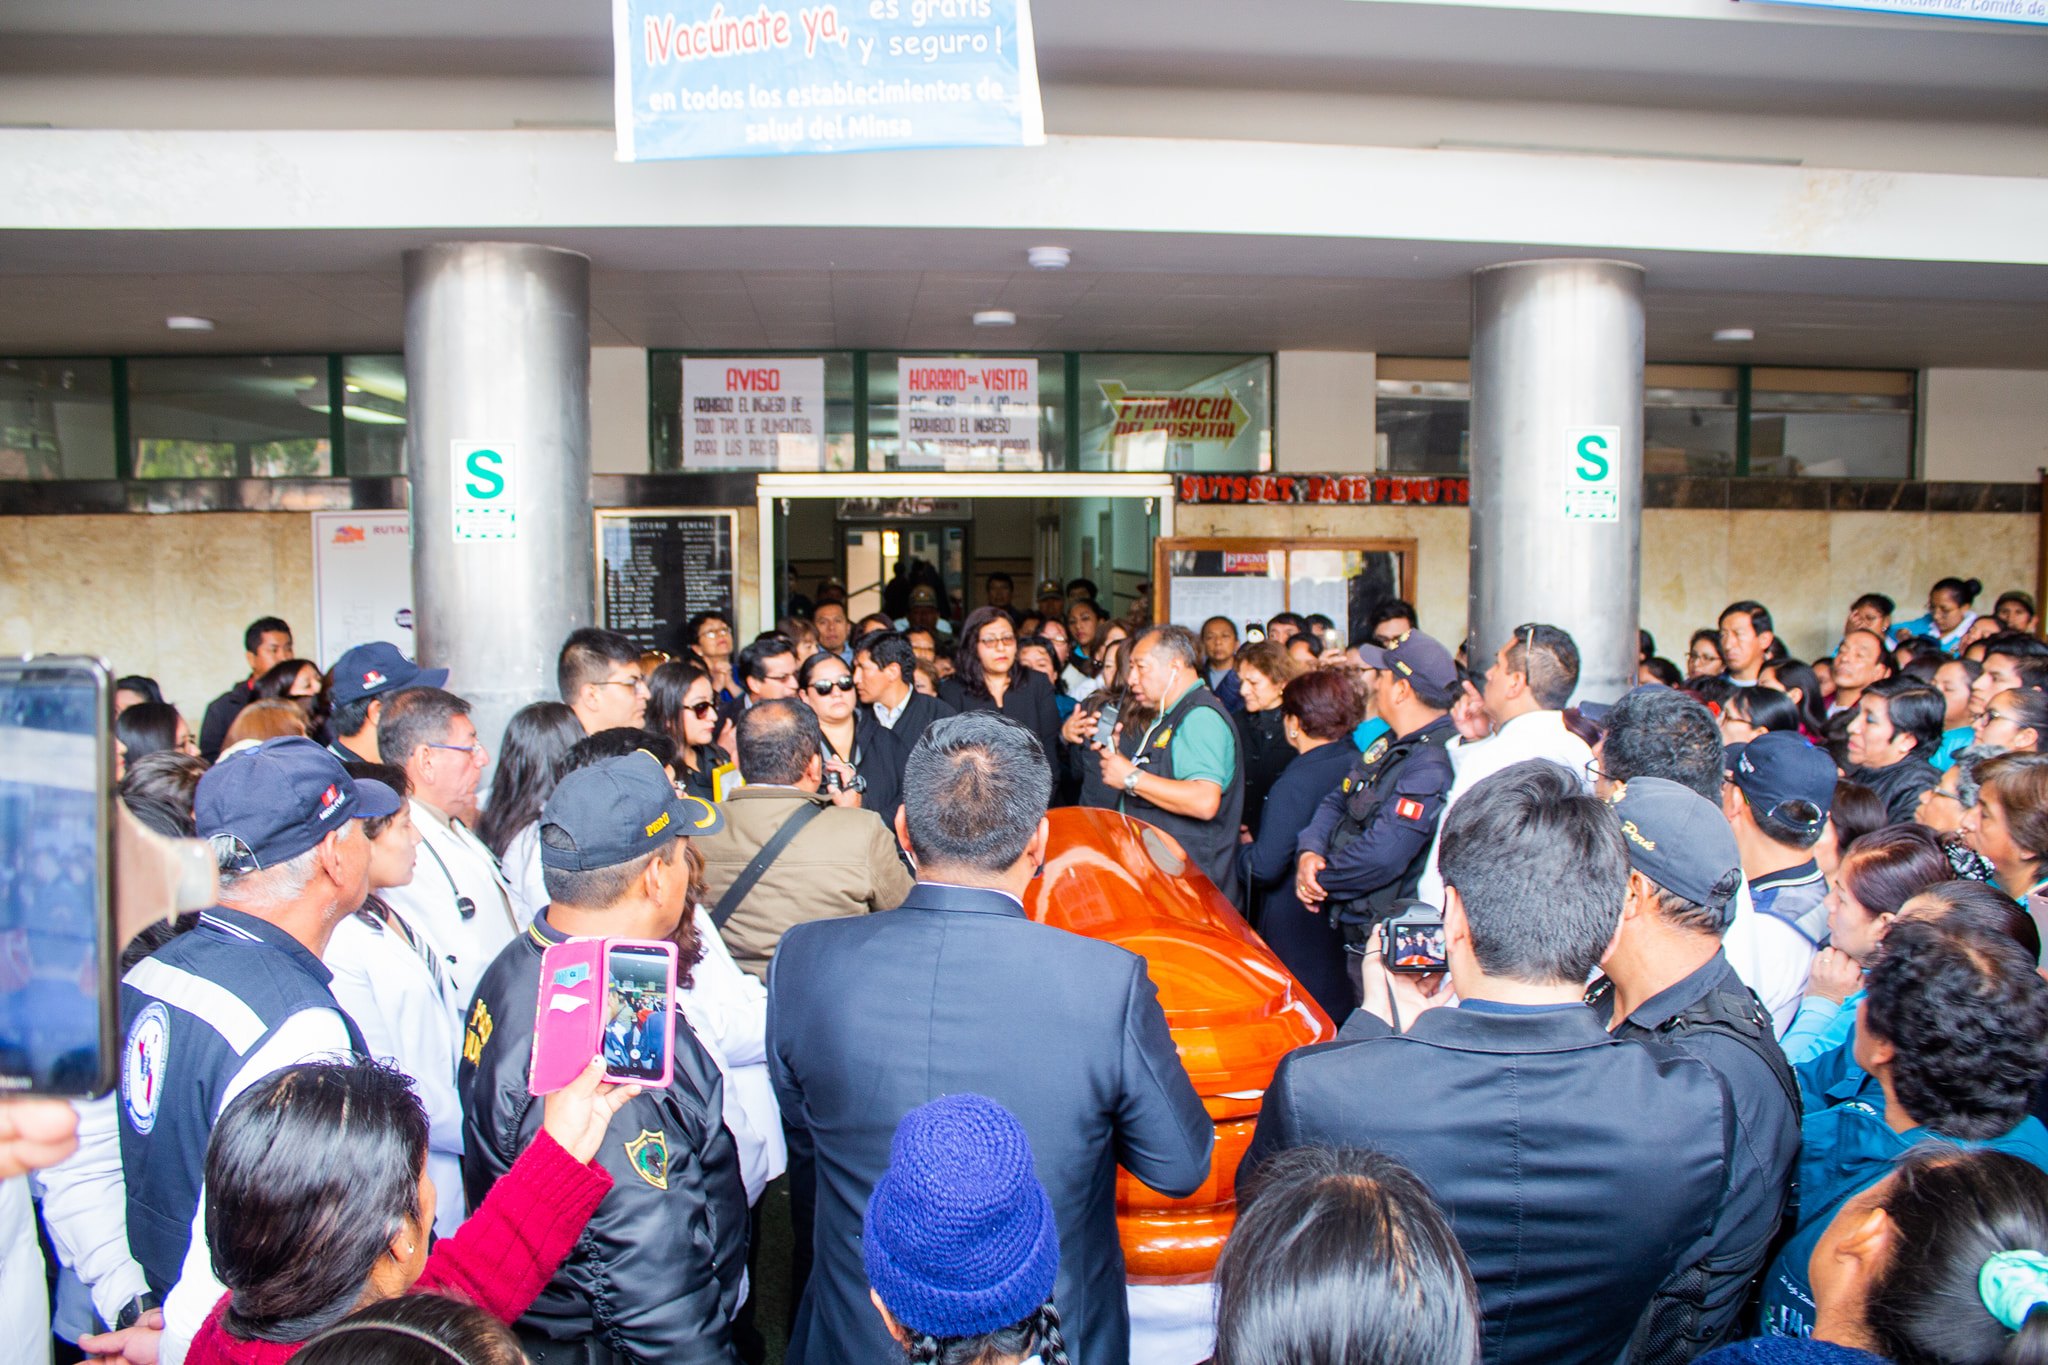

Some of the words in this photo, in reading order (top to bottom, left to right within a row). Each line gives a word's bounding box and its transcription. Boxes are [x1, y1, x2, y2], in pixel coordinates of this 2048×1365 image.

[869, 0, 899, 20] es
[911, 0, 992, 28] gratis
[2027, 4, 2046, 16] de
[801, 8, 848, 57] ya,
[858, 36, 876, 65] y
[649, 91, 676, 111] en
[681, 86, 744, 111] todos
[749, 84, 782, 109] los
[787, 77, 971, 108] establecimientos
[975, 77, 1003, 100] de
[745, 115, 801, 142] salud
[808, 115, 844, 141] del
[848, 111, 912, 139] Minsa
[726, 368, 780, 391] AVISO
[909, 368, 966, 391] HORARIO
[968, 376, 979, 385] DE
[982, 368, 1028, 391] VISITA
[738, 397, 749, 412] EL
[791, 397, 803, 412] DE
[694, 418, 715, 434] TODO
[720, 418, 738, 434] TIPO
[745, 418, 756, 434] DE
[761, 418, 812, 434] ALIMENTOS
[909, 417, 956, 433] PROHIBIDO
[960, 417, 969, 433] EL
[974, 417, 1010, 433] INGRESO
[1152, 421, 1235, 438] HOSPITAL
[694, 440, 717, 455] PARA
[725, 440, 742, 455] LOS
[1576, 434, 1609, 482] S
[465, 449, 505, 500] S
[1181, 475, 1295, 500] SUTSSAT
[1309, 476, 1368, 499] BASE
